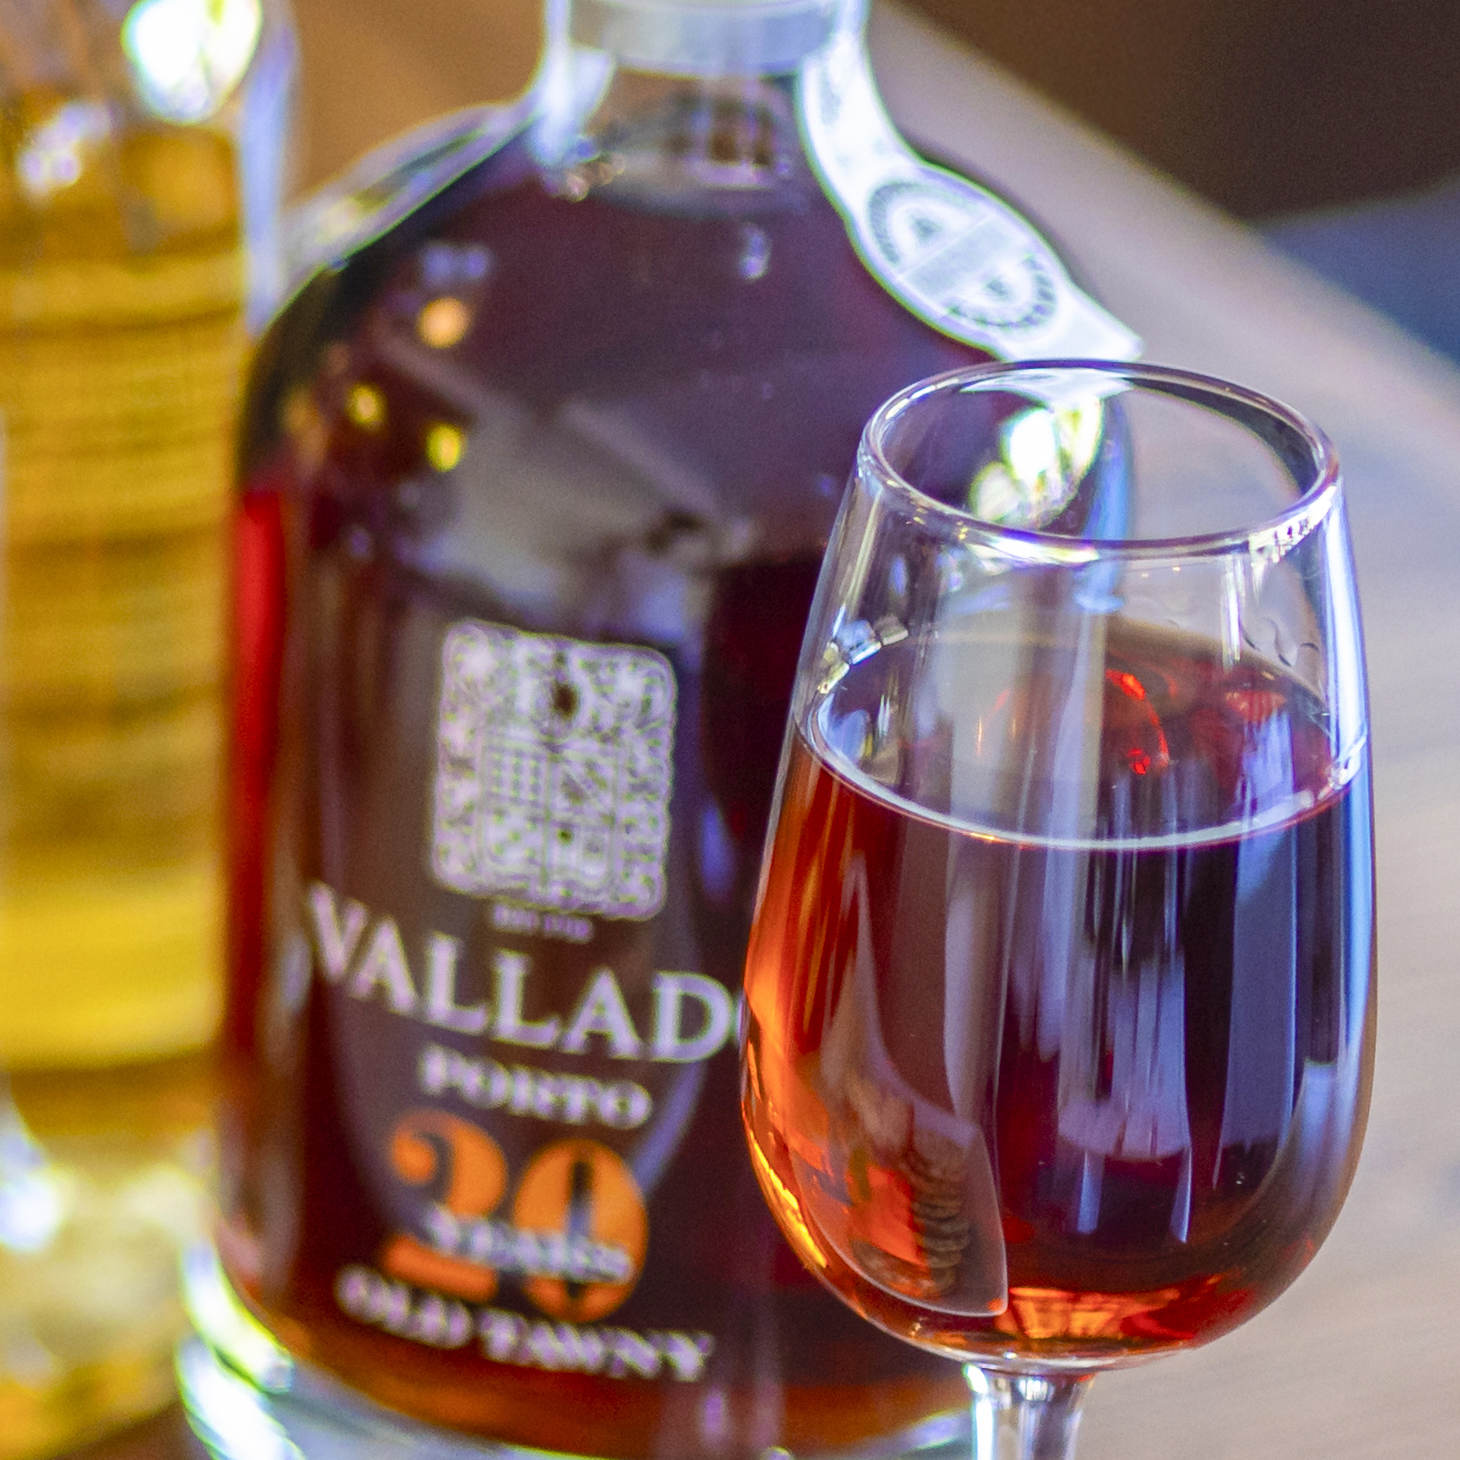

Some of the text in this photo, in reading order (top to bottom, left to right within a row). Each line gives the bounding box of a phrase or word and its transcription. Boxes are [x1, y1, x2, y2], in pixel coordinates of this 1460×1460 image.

[308, 878, 746, 1064] VALLAD
[417, 1042, 655, 1132] PORTO
[383, 1108, 650, 1322] 20
[333, 1264, 716, 1384] OLD TAWNY
